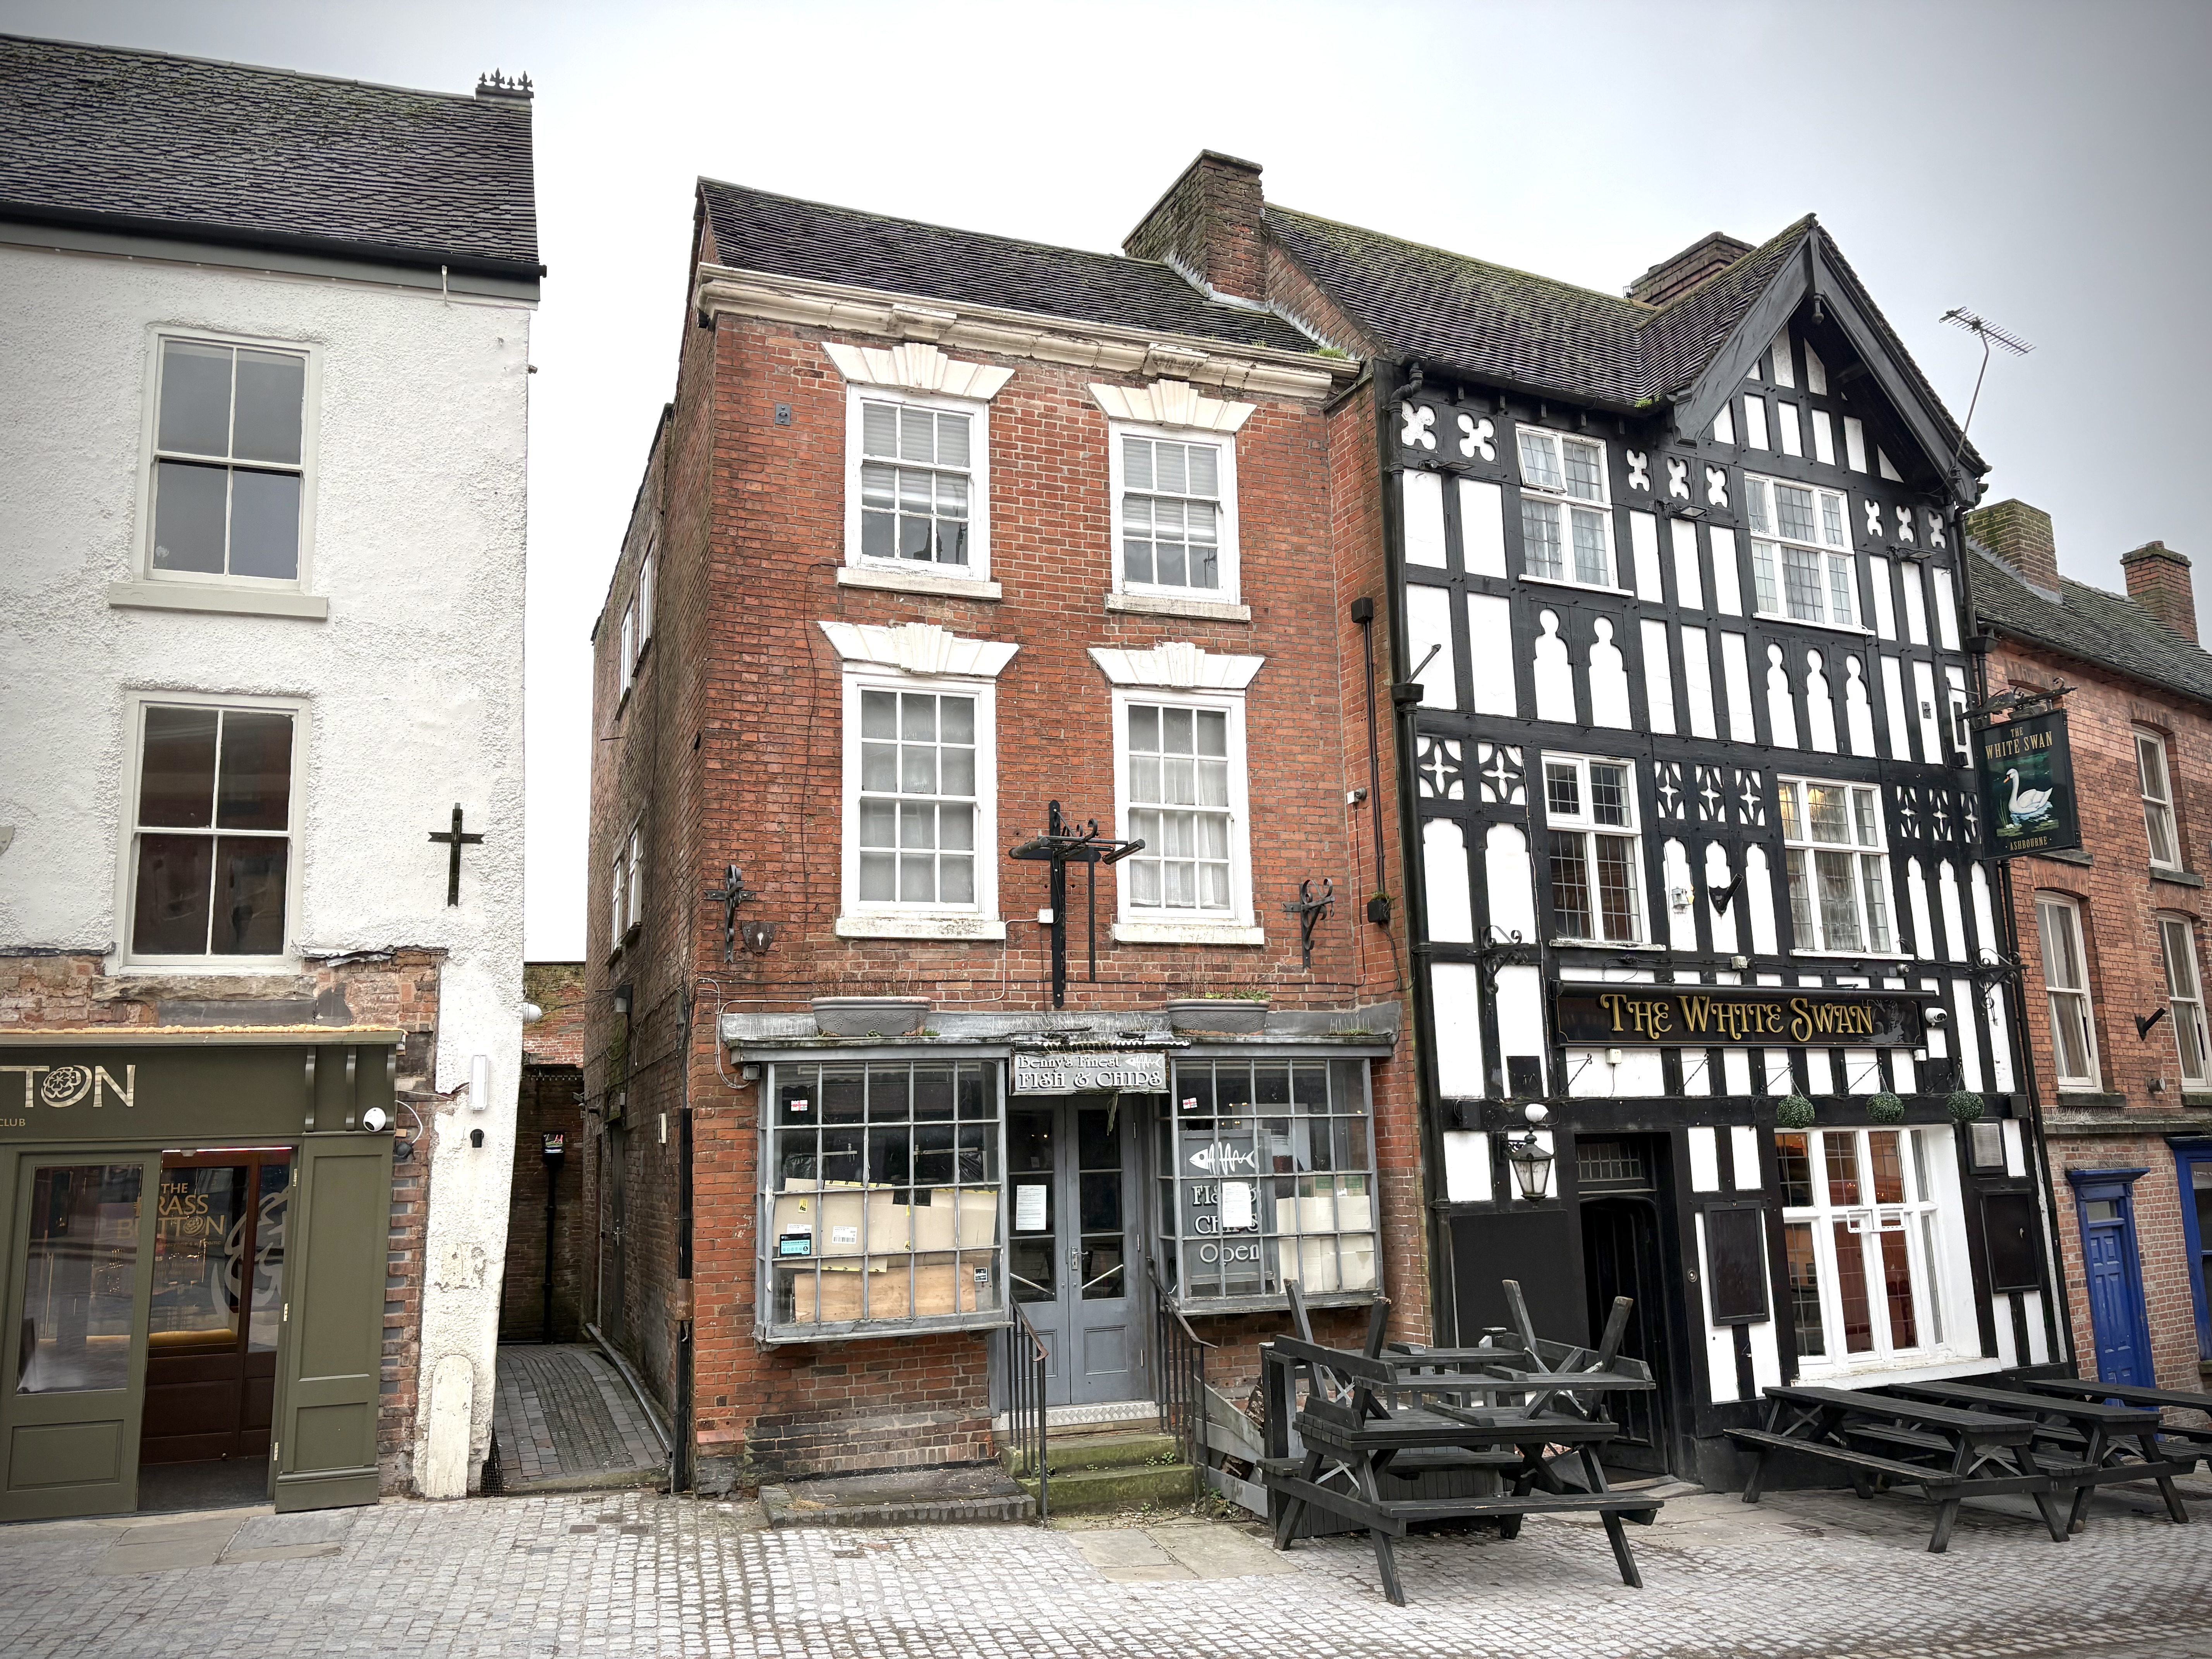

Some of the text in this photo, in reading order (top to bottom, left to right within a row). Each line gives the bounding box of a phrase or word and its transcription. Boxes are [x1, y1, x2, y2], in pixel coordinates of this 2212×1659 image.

[2011, 726, 2023, 738] THE
[1985, 731, 2053, 760] WHITE SWAN
[2010, 836, 2048, 851] ASHBOURNE
[1601, 994, 1873, 1042] THE WHITE SWAN
[1019, 1055, 1121, 1071] Benny's Finest
[1020, 1070, 1162, 1088] FISH & CHIPS
[161, 1183, 188, 1194] THE
[133, 1194, 209, 1216] RASS
[117, 1215, 225, 1238] BTTON
[1200, 1243, 1259, 1265] Open
